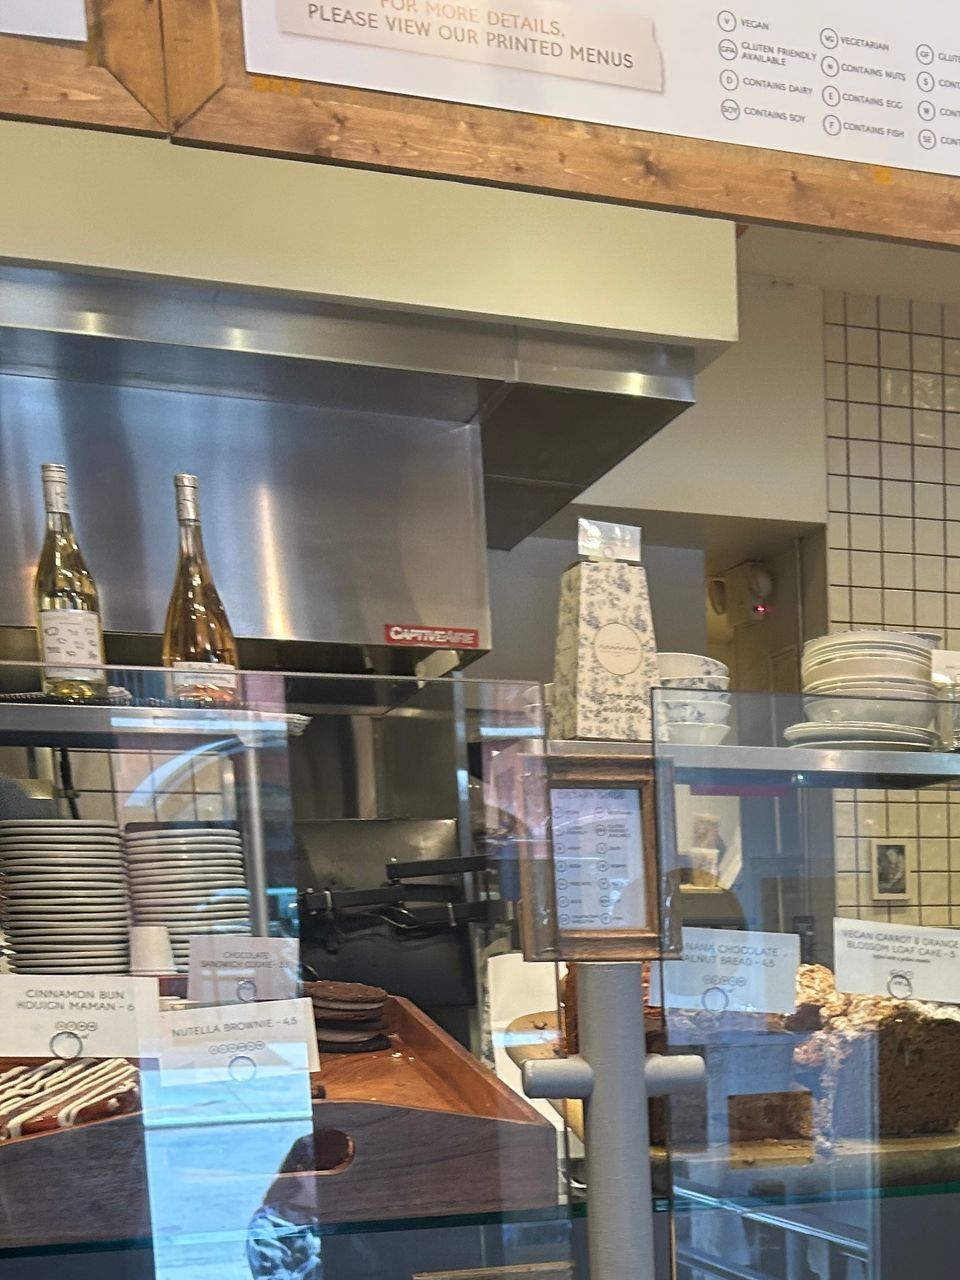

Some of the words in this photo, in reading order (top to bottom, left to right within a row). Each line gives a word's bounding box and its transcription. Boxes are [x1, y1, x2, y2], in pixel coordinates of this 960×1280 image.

[380, 0, 417, 13] FOR
[426, 2, 480, 23] MORE
[488, 10, 565, 38] DETAILS.
[741, 18, 769, 30] VEGAN
[308, 4, 378, 29] PLEASE
[385, 16, 430, 36] VIEW
[439, 25, 479, 44] OUR
[487, 32, 563, 58] PRINTED
[570, 45, 634, 69] MENUS
[840, 36, 889, 51] VEGETARIAN
[741, 41, 774, 54] GLUTEN
[777, 47, 816, 61] FRIENDLY
[741, 52, 786, 66] AVAILABLE
[841, 64, 883, 78] CONTAINS
[885, 70, 906, 81] NUTS
[743, 77, 786, 91] CONTAINS
[788, 85, 814, 96] DAIRY
[842, 93, 884, 107] CONTAINS
[886, 99, 903, 110] EGG
[744, 107, 787, 121] CONTAINS
[789, 114, 806, 124] SOY
[843, 122, 885, 136] CONTAINS
[886, 128, 905, 138] FISH
[847, 940, 890, 952] BLOSSOM
[892, 945, 917, 954] LOAF
[918, 948, 942, 958] CAKE
[875, 933, 912, 942] CARROT
[921, 937, 959, 949] ORANGE
[717, 943, 779, 957] CHOCOLATE
[720, 956, 753, 966] BREAD
[25, 988, 95, 1000] CINNAMON
[99, 990, 125, 1000] BUN
[68, 1001, 116, 1011] MAMAN
[172, 1026, 221, 1038] NUTELLA
[223, 1018, 273, 1032] BROWNIE
